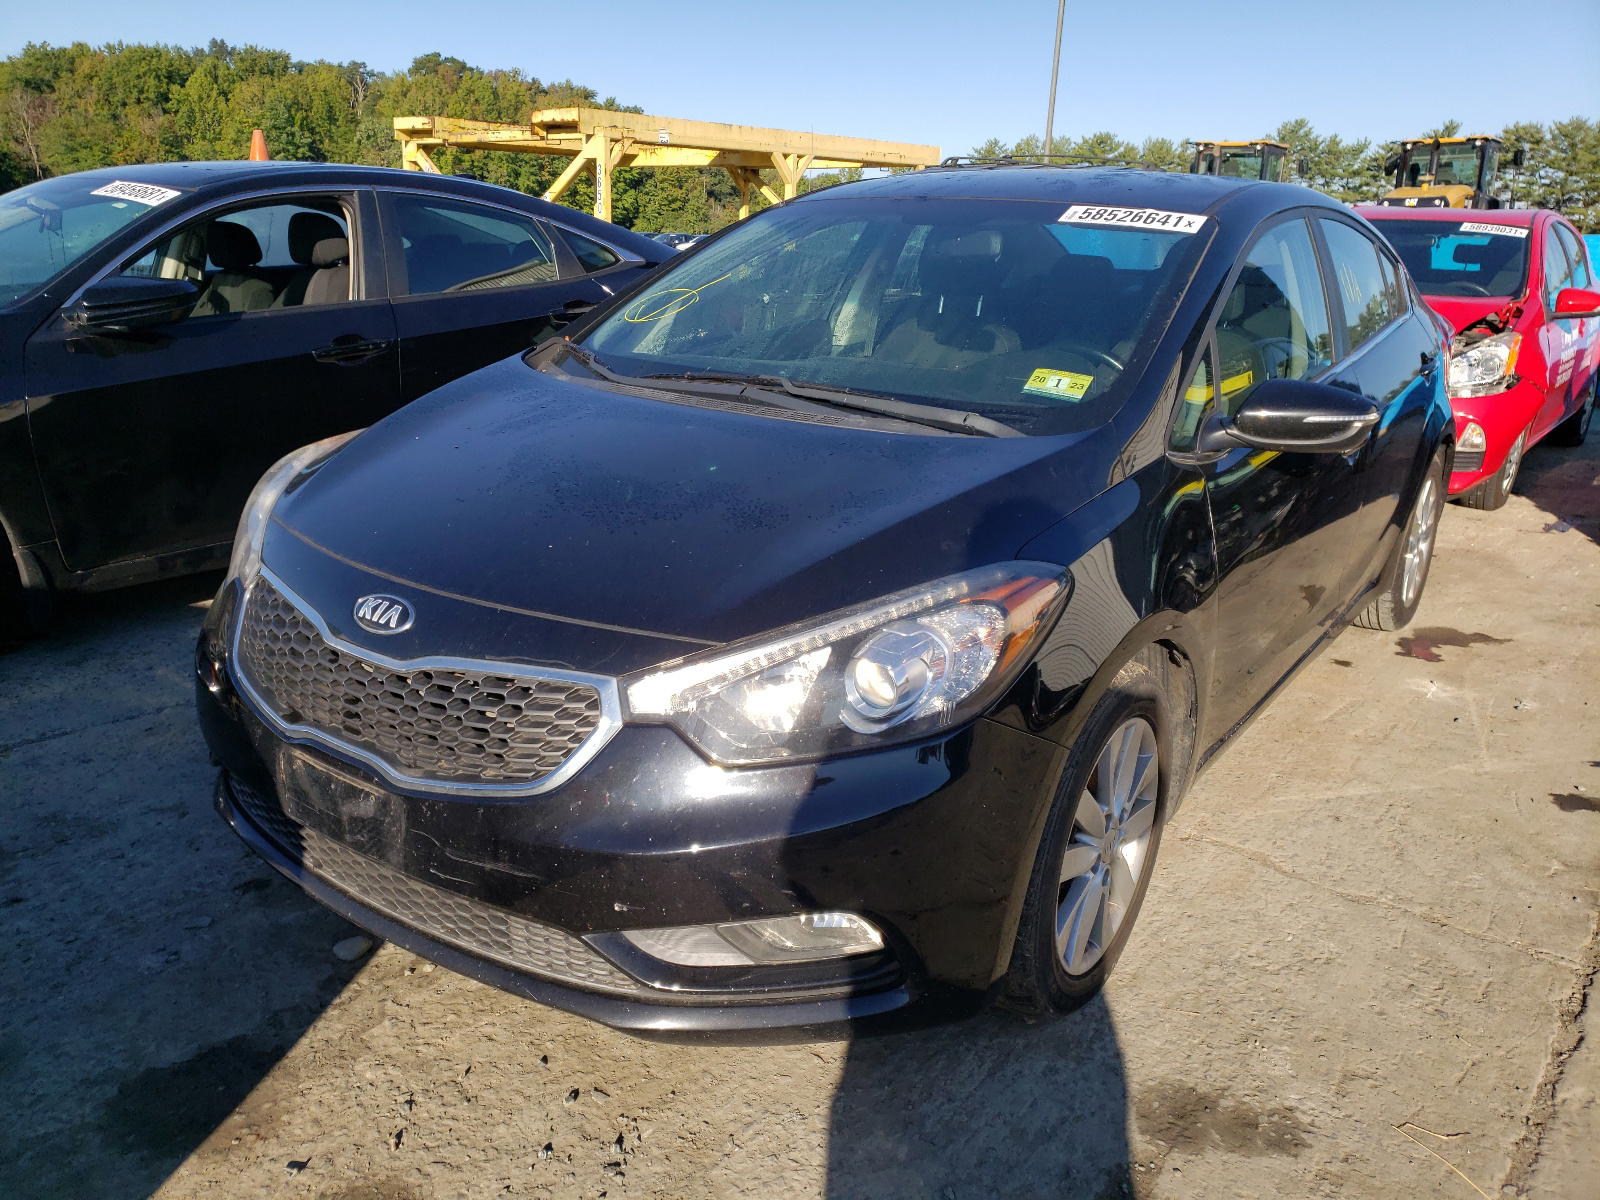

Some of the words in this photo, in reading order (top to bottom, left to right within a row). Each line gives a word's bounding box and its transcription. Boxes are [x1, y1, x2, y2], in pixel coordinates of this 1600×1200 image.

[1032, 375, 1047, 383] 20
[1052, 378, 1063, 389] 1
[1069, 382, 1085, 390] 23
[358, 597, 402, 629] KIA
